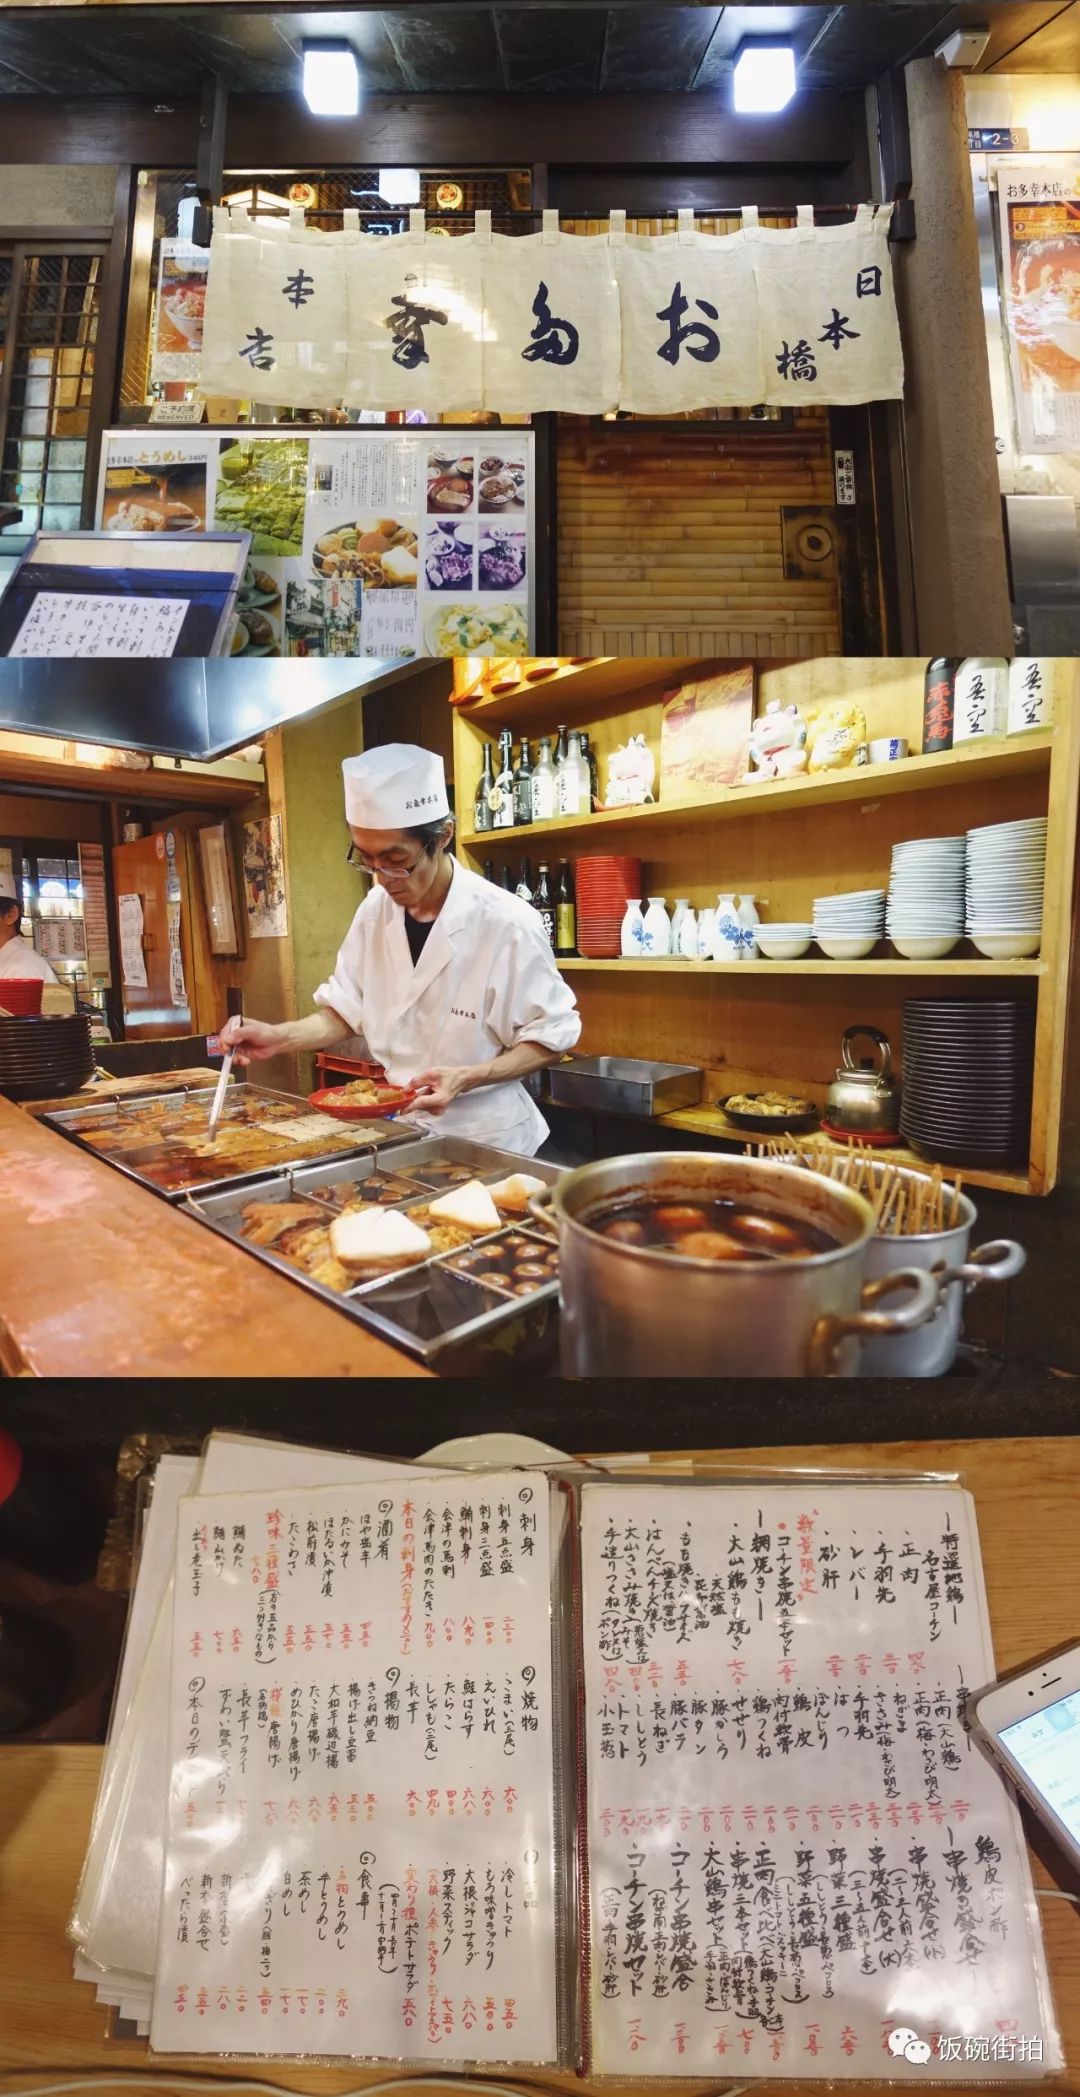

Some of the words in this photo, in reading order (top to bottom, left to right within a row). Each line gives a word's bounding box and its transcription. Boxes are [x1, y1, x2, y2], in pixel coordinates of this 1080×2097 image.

[339, 1516, 354, 1569] かにみそ
[374, 1520, 393, 1560] 酒肴
[440, 1507, 455, 1579] 会津の馬刺
[479, 1504, 494, 1578] 刺身三点盛
[497, 1503, 515, 1574] 刺身五点盛
[519, 1513, 536, 1556] 刺身
[818, 1544, 841, 1590] 砂肝
[849, 1545, 865, 1601] レバー
[873, 1542, 896, 1604] 手羽先
[899, 1542, 921, 1585] 正肉
[385, 1691, 399, 1730] 揚物
[405, 1680, 420, 1724] 長芋
[483, 1680, 496, 1734] えいひれ
[521, 1691, 538, 1732] 焼物
[650, 1701, 670, 1753] 長ねぎ
[670, 1700, 689, 1751] 豚バラ
[691, 1699, 708, 1755] 豚タン
[732, 1696, 750, 1750] せせり
[752, 1695, 772, 1759] 鶏つくね
[793, 1693, 816, 1748] 鶏皮
[853, 1692, 873, 1741] 手羽先
[618, 1703, 629, 1760] トマト
[637, 1703, 647, 1767] ししとう
[282, 1871, 293, 1917] 白めし
[298, 1871, 312, 1914] 茶めし
[356, 1868, 373, 1920] 食事
[501, 1868, 515, 1939] 冷しトマト
